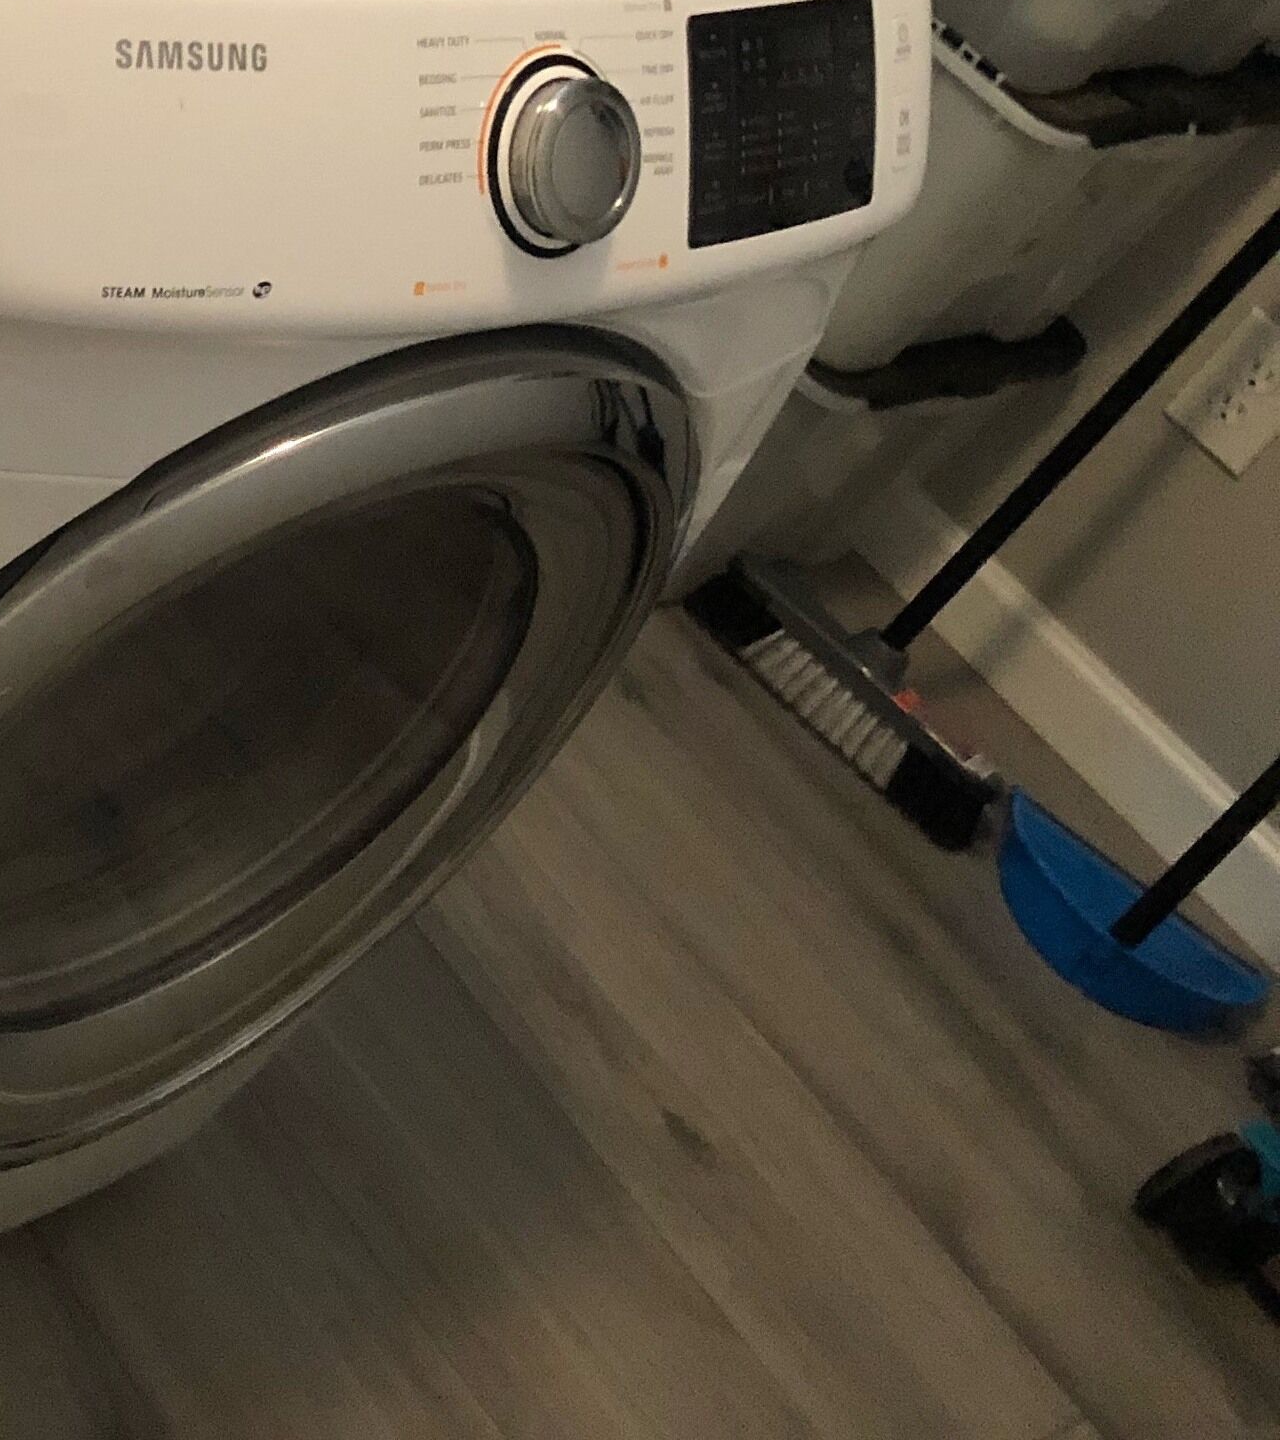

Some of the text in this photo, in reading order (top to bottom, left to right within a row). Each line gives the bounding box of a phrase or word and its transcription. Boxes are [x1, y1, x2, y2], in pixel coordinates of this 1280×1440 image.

[416, 35, 470, 49] HEAVY DUTY
[114, 37, 268, 73] SAMSUNG
[418, 72, 457, 86] BEDDING
[419, 105, 457, 119] SANITIZE
[419, 138, 471, 152] PERM PRESS
[418, 171, 463, 187] DELICATES
[101, 286, 146, 300] STEAM
